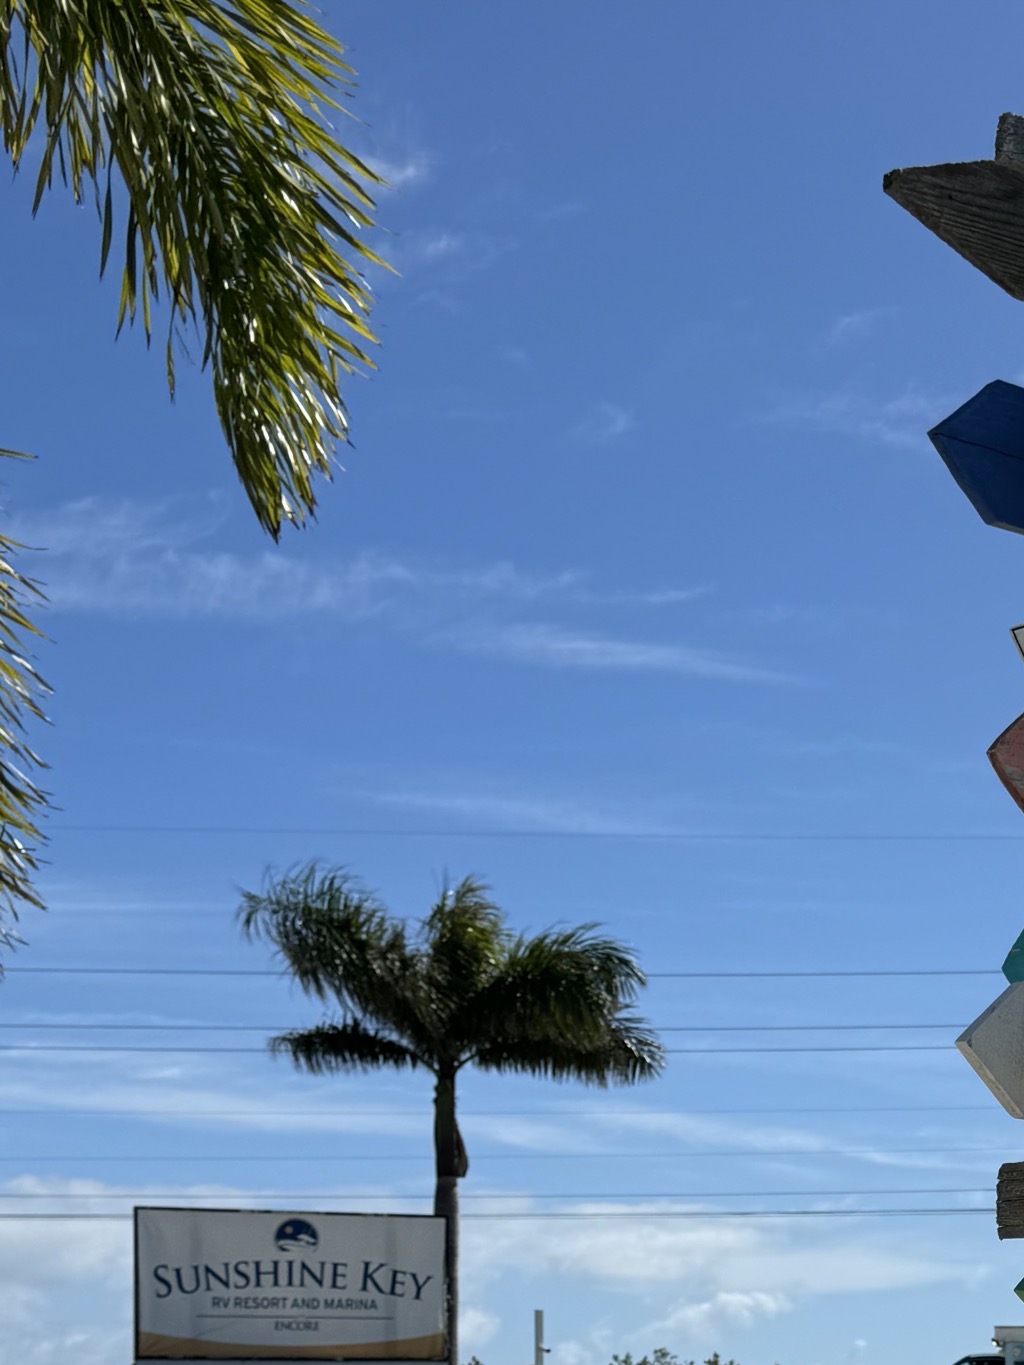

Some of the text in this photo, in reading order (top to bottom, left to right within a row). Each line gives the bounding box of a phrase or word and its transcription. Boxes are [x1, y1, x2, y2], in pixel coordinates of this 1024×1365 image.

[152, 1259, 435, 1301] SUNSHINE KEY
[212, 1296, 379, 1311] RV RESORT AND MARINA
[273, 1319, 320, 1332] ENCORE
